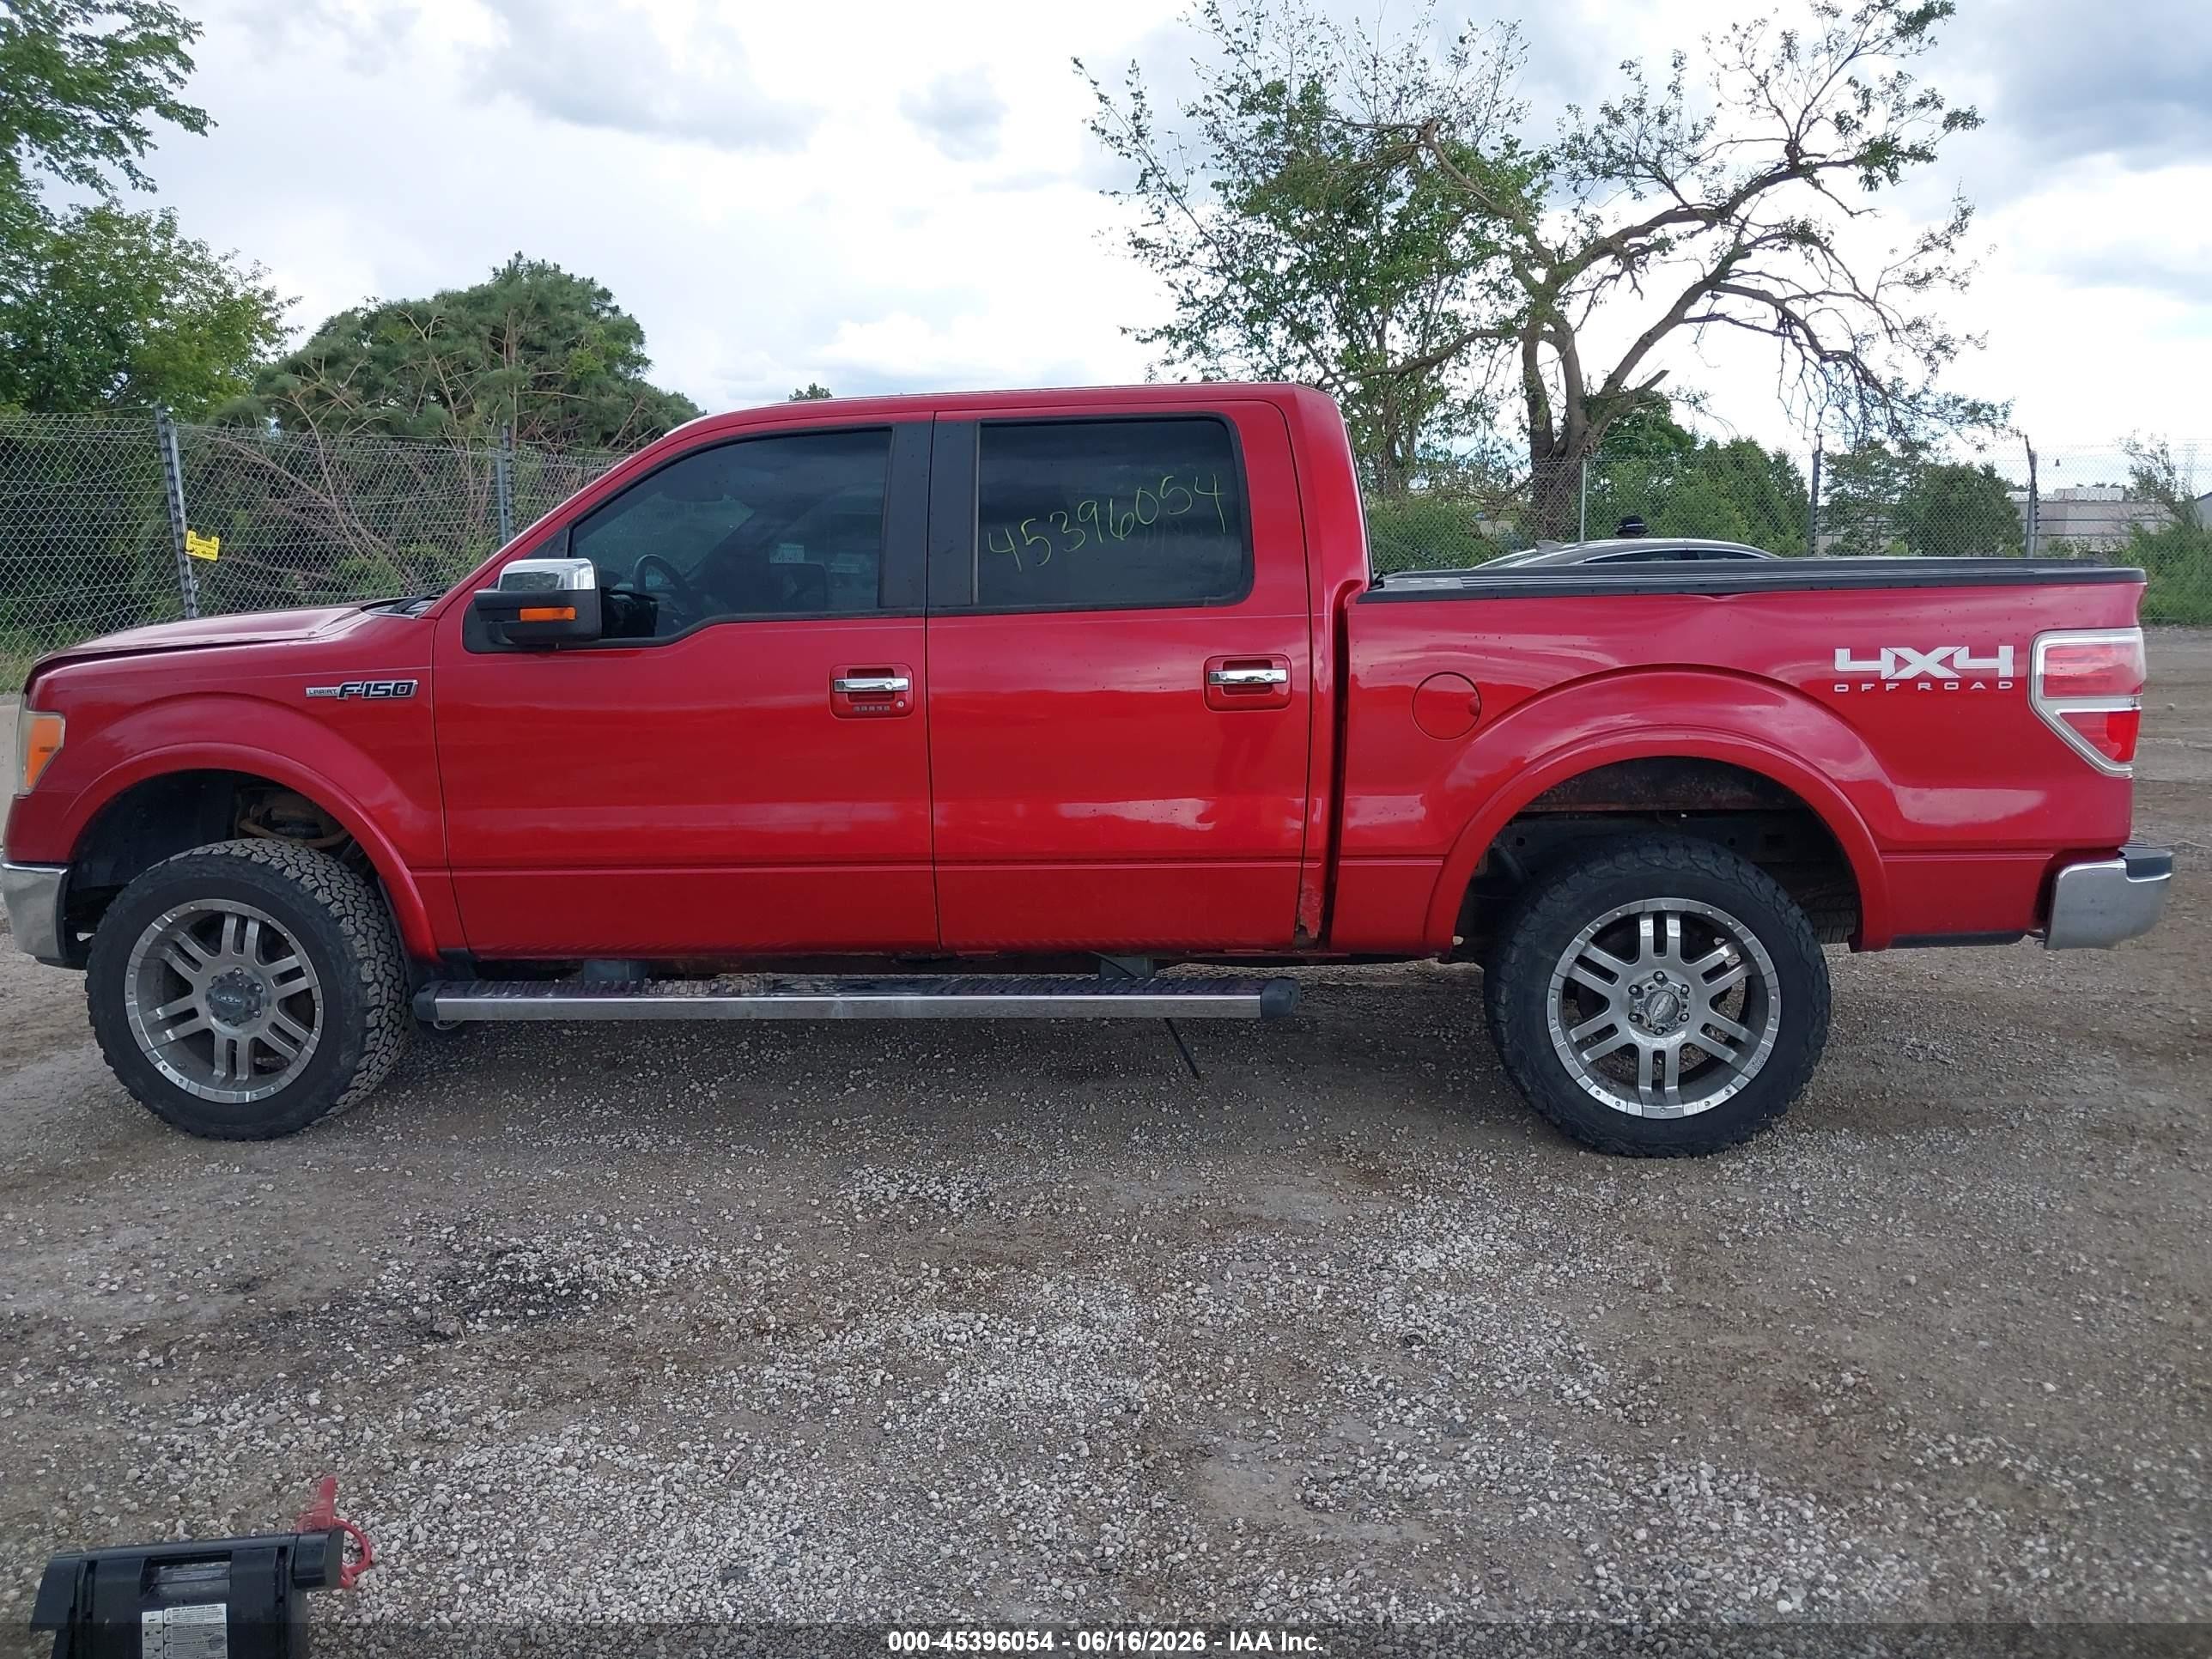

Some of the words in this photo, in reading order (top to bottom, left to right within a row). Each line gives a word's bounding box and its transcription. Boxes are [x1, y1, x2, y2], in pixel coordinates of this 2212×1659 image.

[988, 473, 1225, 572] 45396054
[337, 679, 417, 700] F-150
[1833, 682, 1900, 693] OFF
[1917, 680, 2014, 691] ROAD
